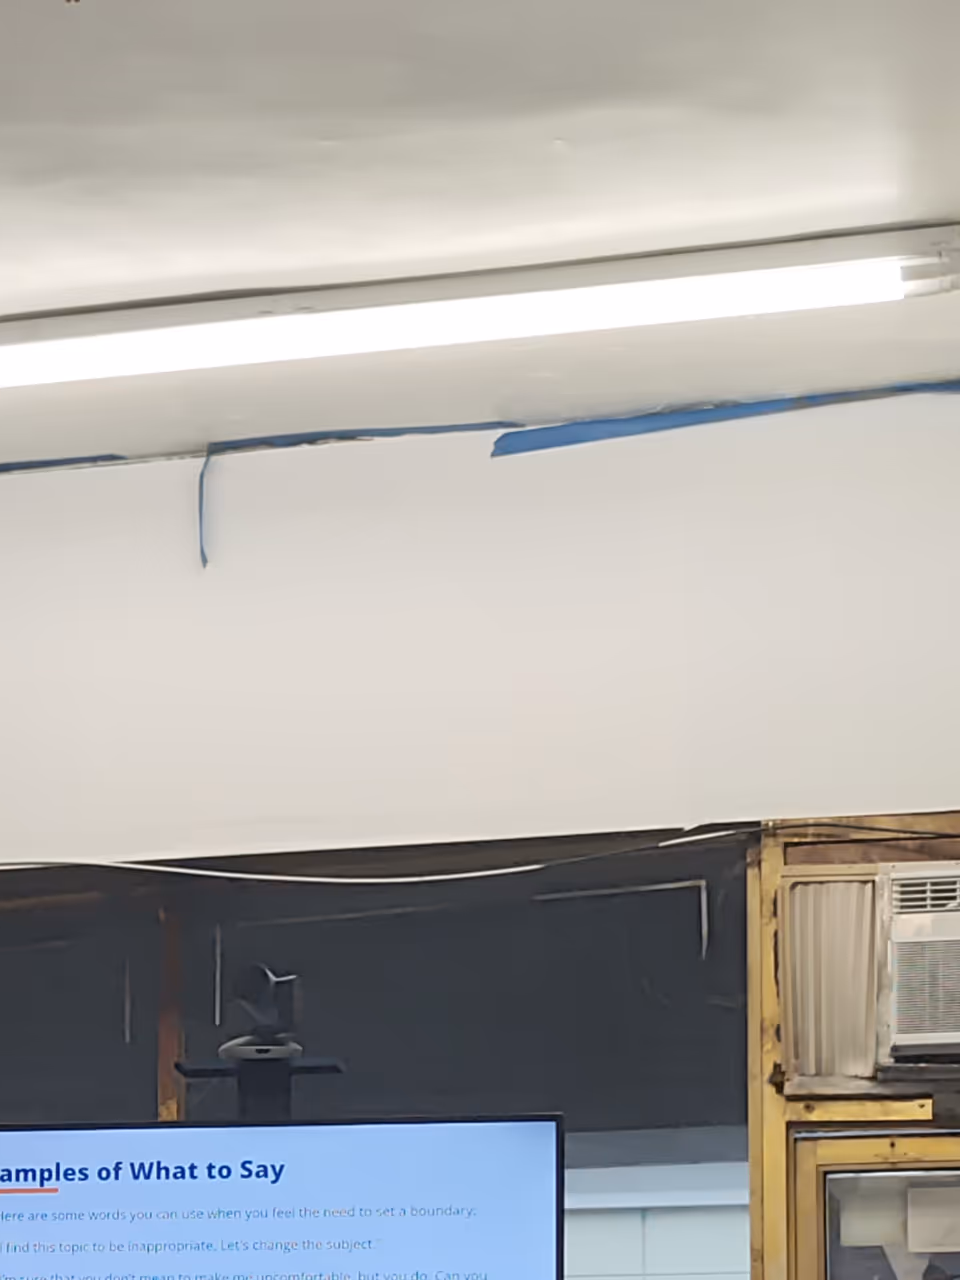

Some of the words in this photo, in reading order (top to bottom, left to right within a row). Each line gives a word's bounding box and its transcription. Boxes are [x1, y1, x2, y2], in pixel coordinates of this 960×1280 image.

[97, 1161, 123, 1181] of
[130, 1161, 198, 1180] What
[206, 1162, 232, 1180] to
[240, 1160, 285, 1184] Say
[28, 1213, 47, 1221] are
[51, 1212, 84, 1221] some
[89, 1209, 126, 1221] words
[130, 1211, 152, 1223] you
[156, 1211, 177, 1220] can
[182, 1210, 204, 1219] use
[207, 1208, 241, 1219] when
[245, 1209, 268, 1222] you
[273, 1207, 294, 1219] feel
[299, 1207, 320, 1218] the
[323, 1206, 355, 1217] need
[359, 1207, 372, 1217] to
[376, 1206, 394, 1217] set
[399, 1208, 406, 1217] a
[6, 1241, 29, 1253] find
[33, 1241, 55, 1253] this
[59, 1241, 88, 1255] topic
[92, 1242, 105, 1252] to
[109, 1241, 124, 1252] be
[128, 1240, 217, 1254] inappropriate.
[221, 1239, 249, 1251] Let's
[252, 1239, 298, 1253] change
[302, 1239, 322, 1250] the
